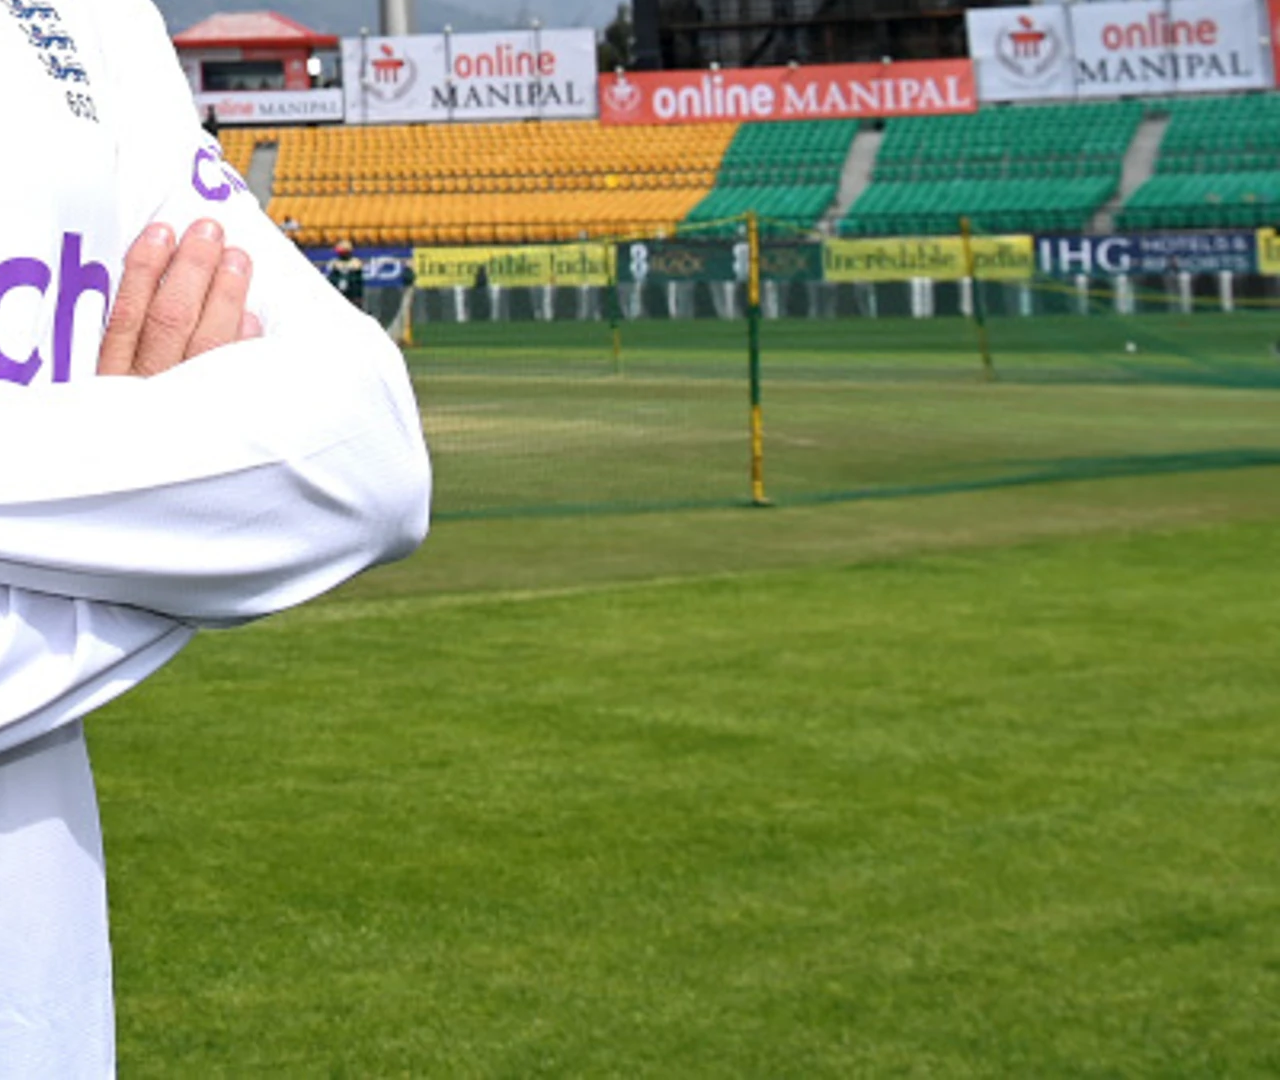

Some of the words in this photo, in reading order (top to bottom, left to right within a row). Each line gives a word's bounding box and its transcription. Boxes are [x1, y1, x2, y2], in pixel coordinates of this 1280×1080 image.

[1101, 12, 1219, 51] online
[454, 43, 556, 79] online
[1077, 51, 1254, 86] MANIPAL
[431, 80, 584, 110] MANIPAL
[652, 73, 775, 118] online
[782, 75, 971, 115] MANIPAL
[1040, 236, 1132, 273] IHG
